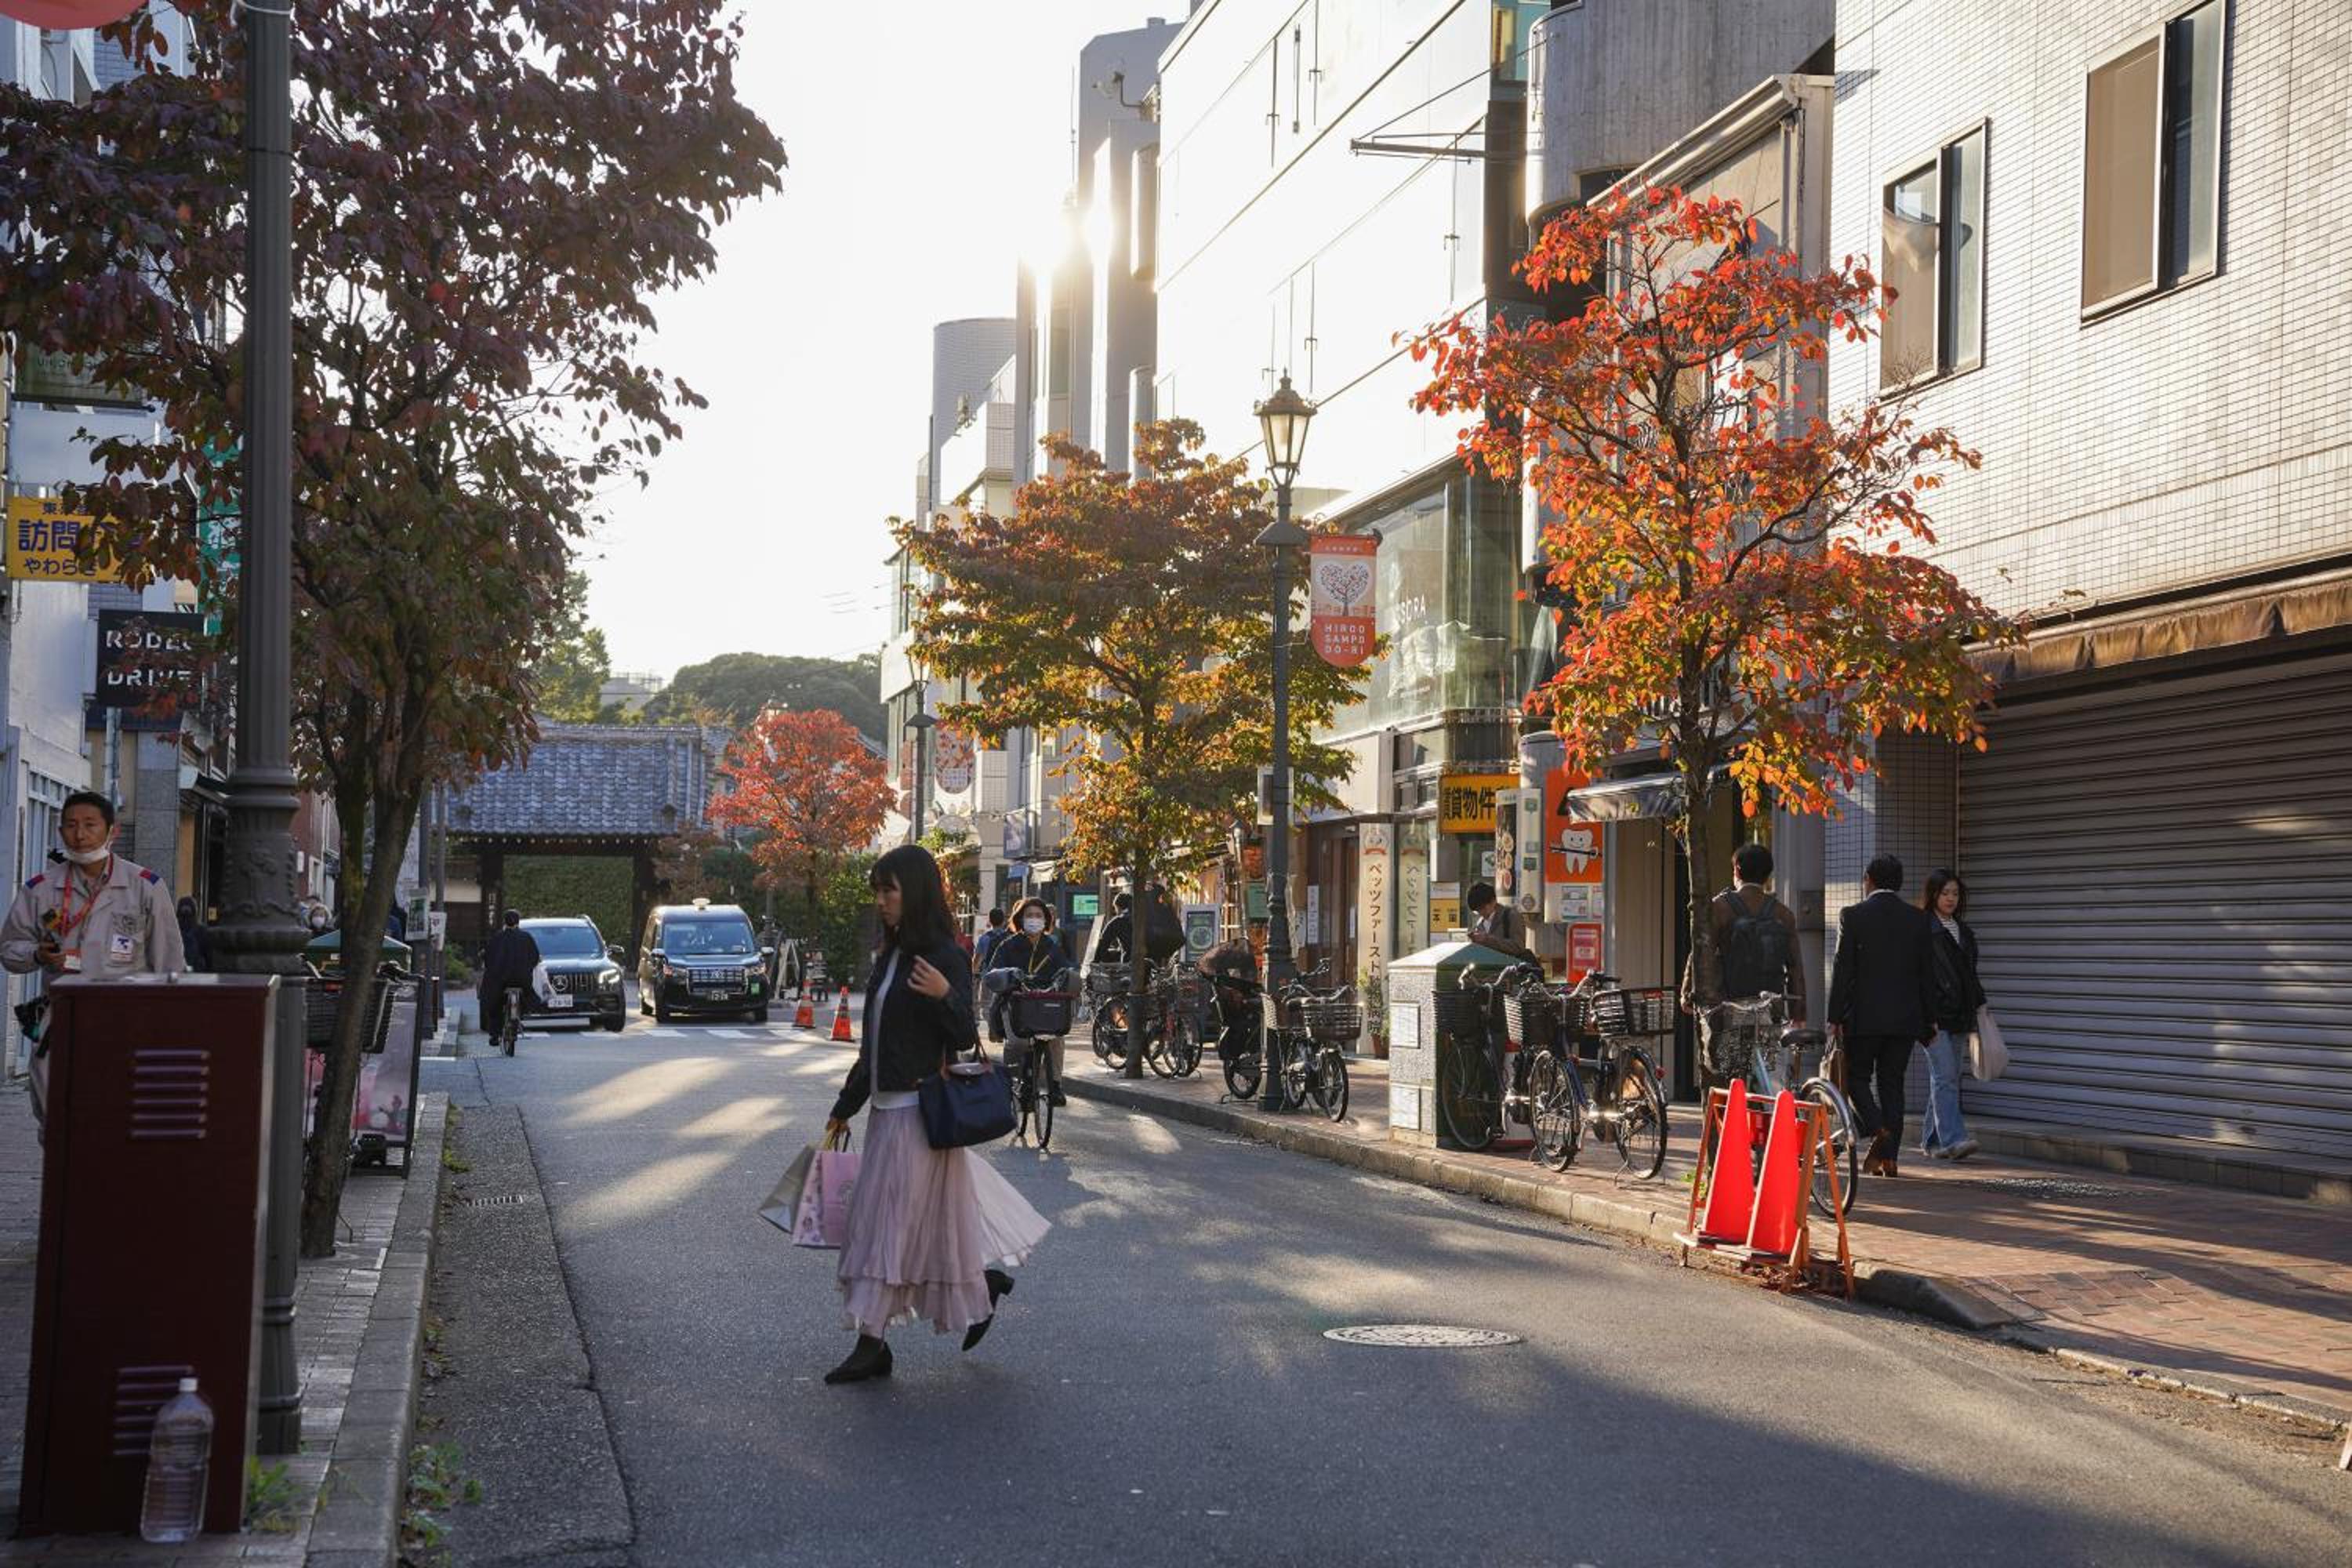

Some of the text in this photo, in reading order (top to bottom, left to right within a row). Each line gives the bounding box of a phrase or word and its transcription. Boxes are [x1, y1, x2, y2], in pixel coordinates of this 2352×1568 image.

[1324, 624, 1366, 633] HIROO
[1324, 634, 1366, 644] SAMPO
[1443, 786, 1511, 822] 賃貸物件
